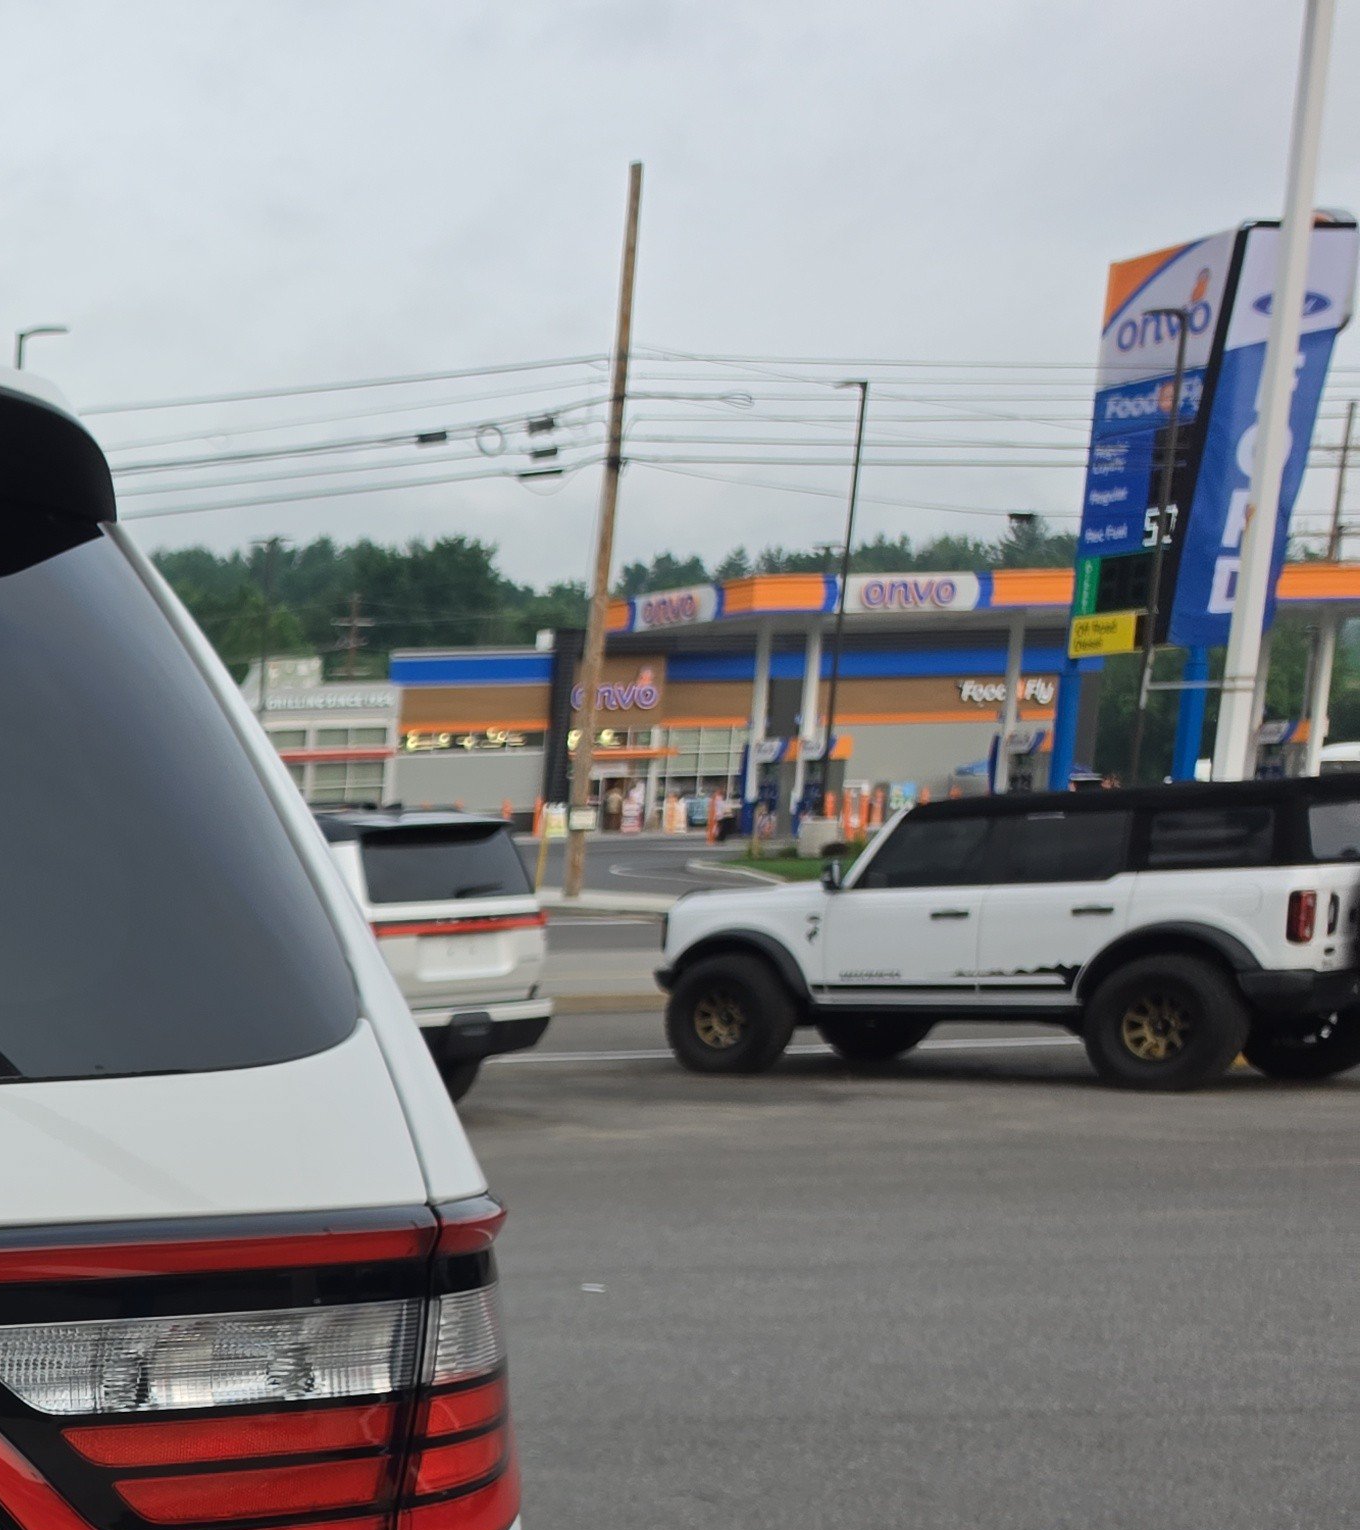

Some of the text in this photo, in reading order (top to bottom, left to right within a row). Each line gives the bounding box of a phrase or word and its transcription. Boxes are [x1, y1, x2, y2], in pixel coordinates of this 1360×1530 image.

[1105, 381, 1159, 422] Food
[861, 579, 956, 608] onvo
[1024, 678, 1055, 704] Fly
